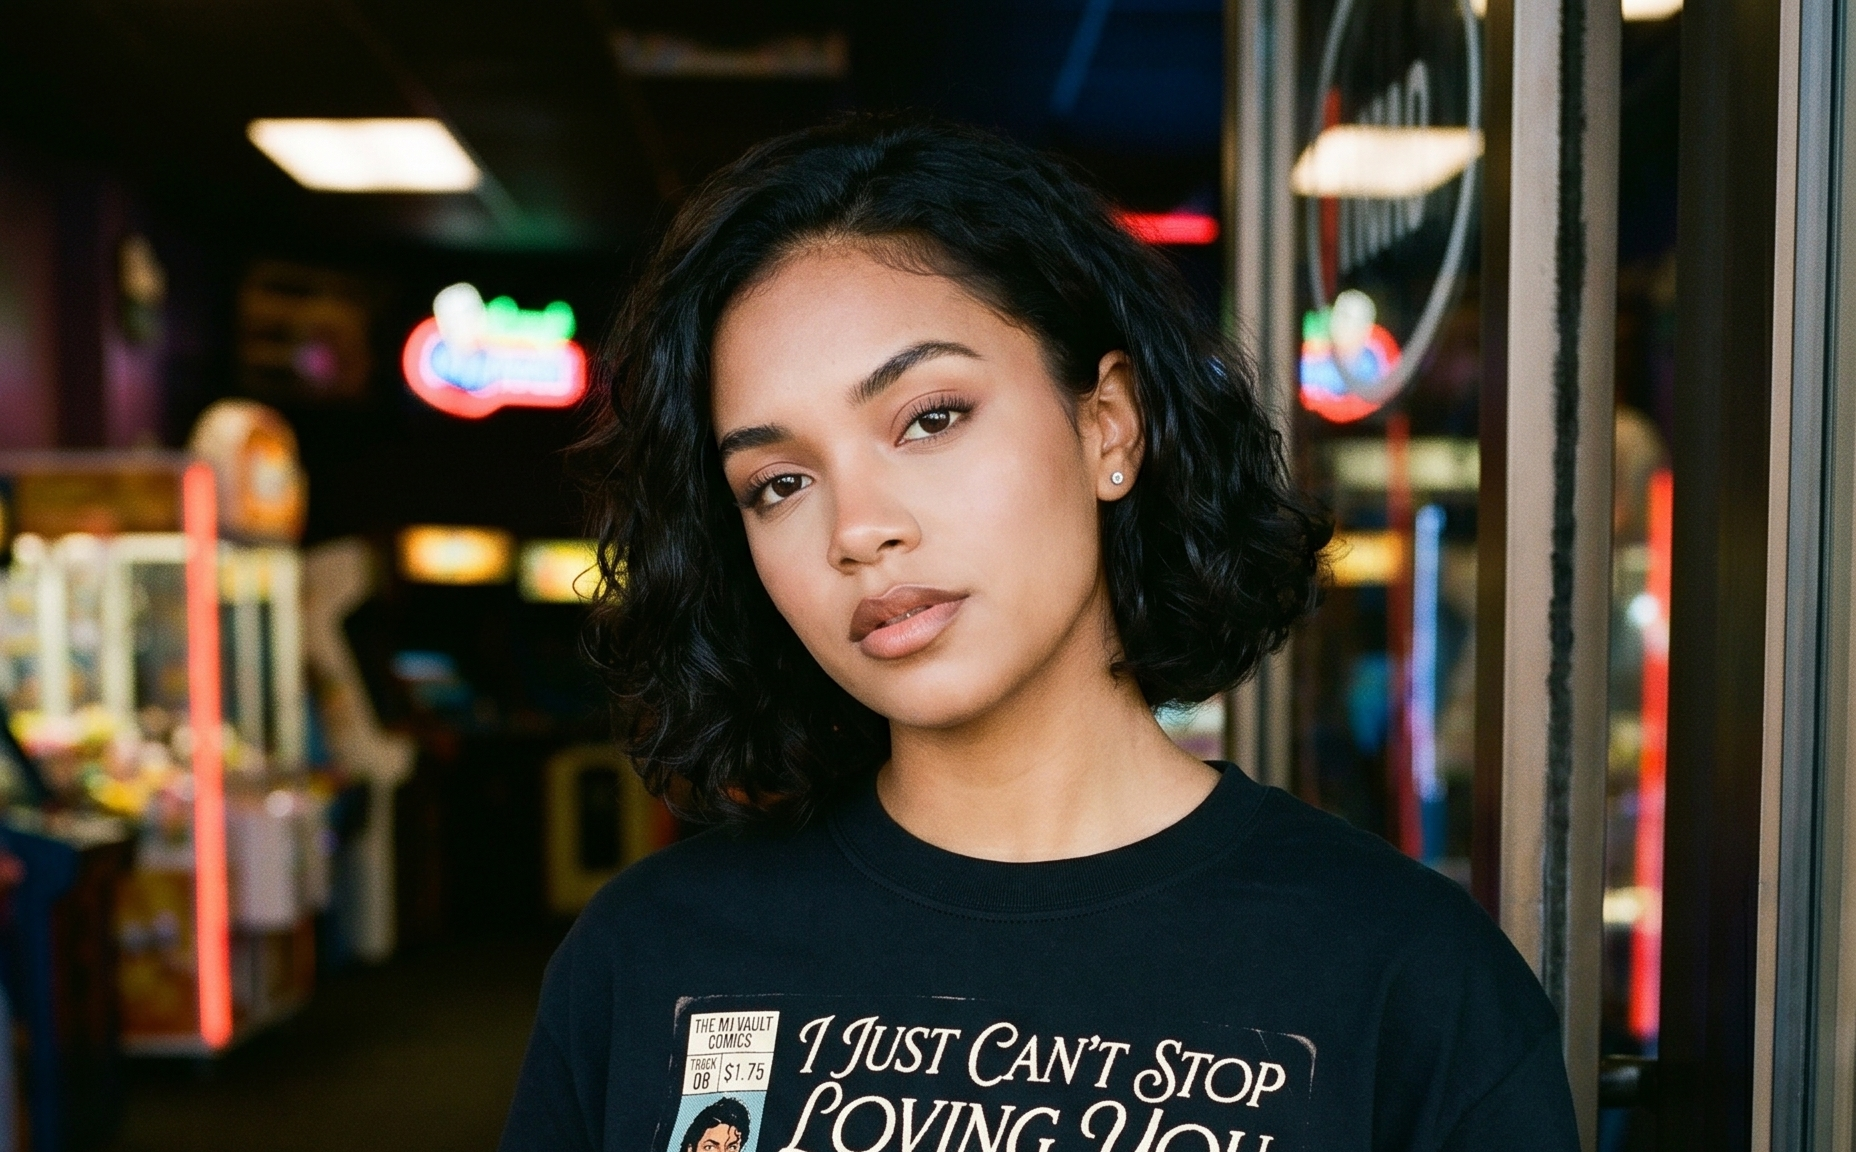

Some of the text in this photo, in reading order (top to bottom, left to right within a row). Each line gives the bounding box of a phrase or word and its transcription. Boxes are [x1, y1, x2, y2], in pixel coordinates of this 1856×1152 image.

[695, 1018, 716, 1034] THE
[737, 1016, 774, 1031] VAULT
[708, 1033, 752, 1050] COMICS
[799, 1015, 836, 1074] I
[968, 1022, 1131, 1088] CAN'T
[1133, 1039, 1287, 1108] STOP
[723, 1062, 765, 1083] $1.75
